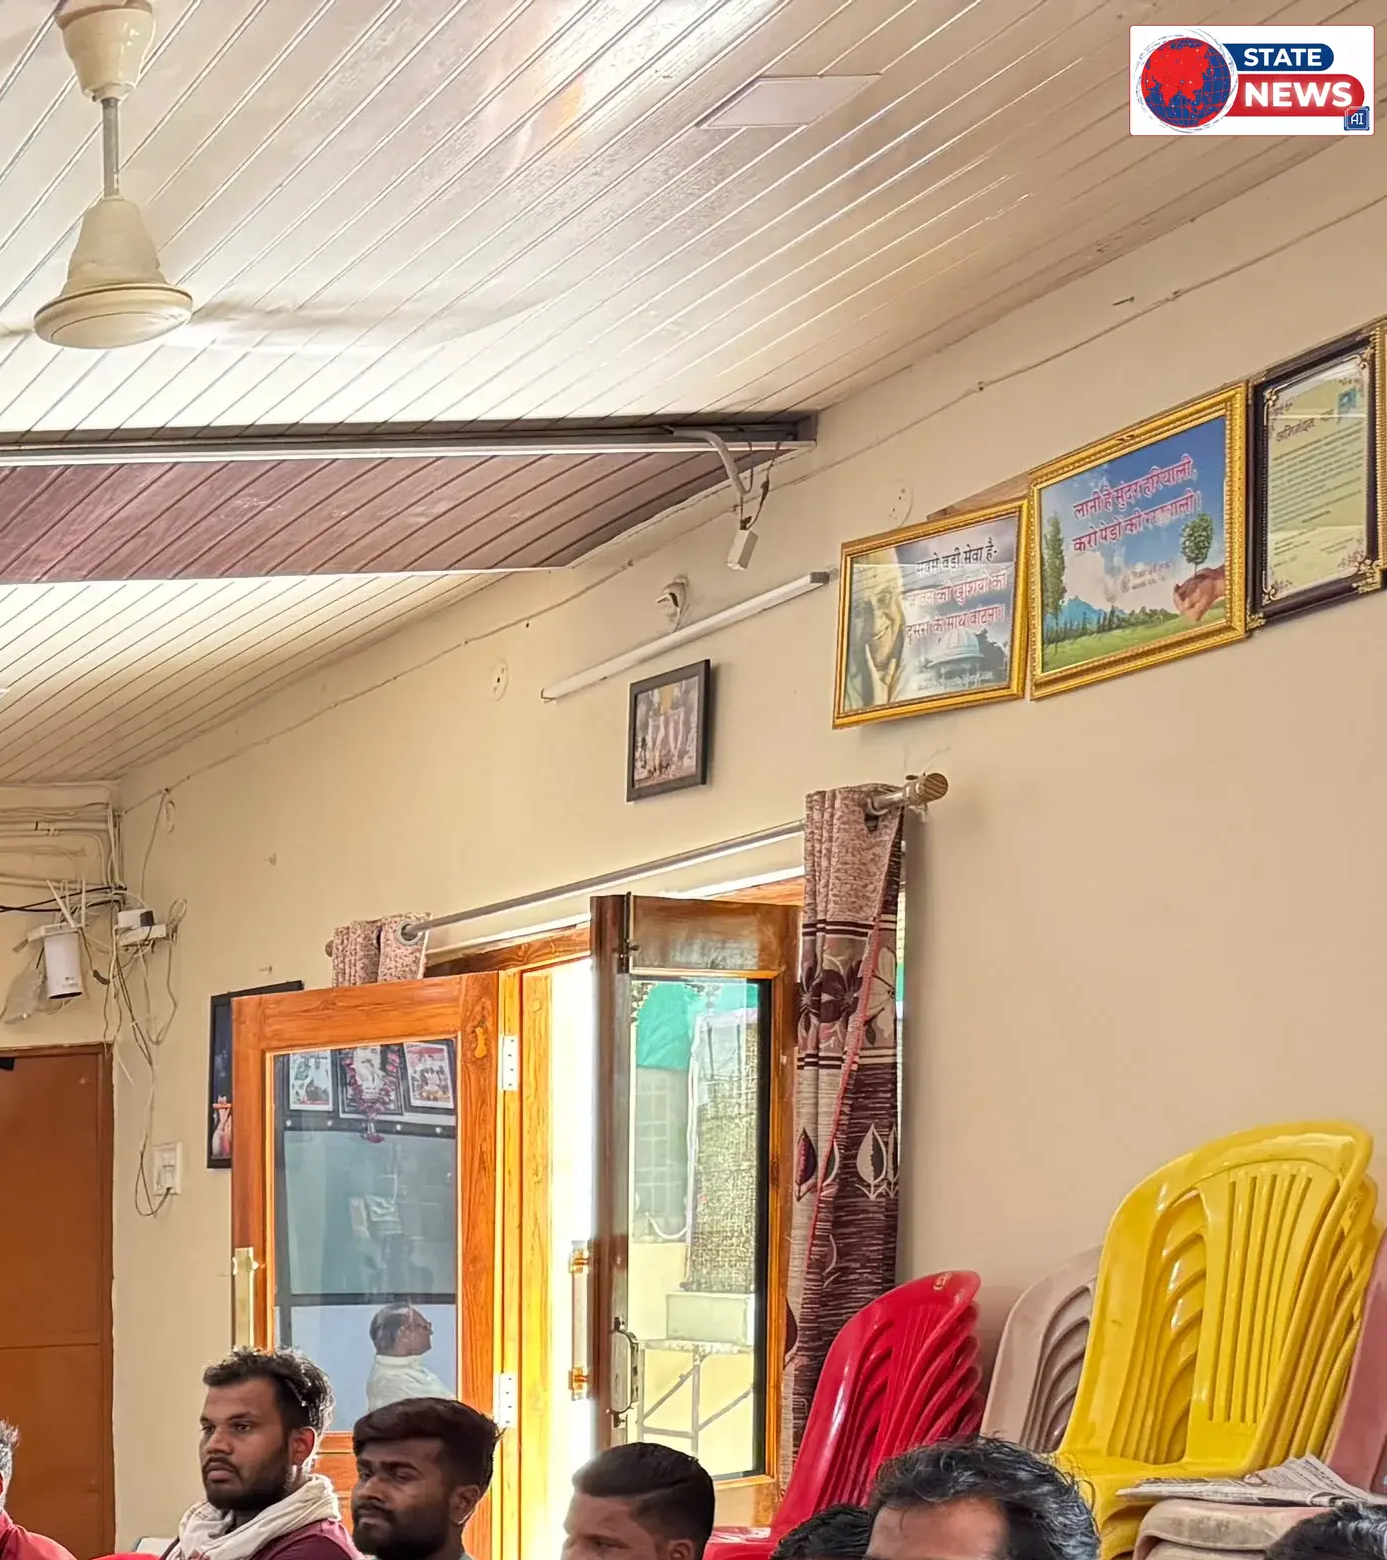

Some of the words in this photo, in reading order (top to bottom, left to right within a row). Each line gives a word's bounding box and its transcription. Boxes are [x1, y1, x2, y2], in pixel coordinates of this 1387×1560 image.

[1098, 476, 1113, 513] है
[1072, 522, 1099, 551] करो
[1123, 508, 1144, 535] की
[963, 544, 983, 565] सेवा
[945, 611, 967, 630] साथ
